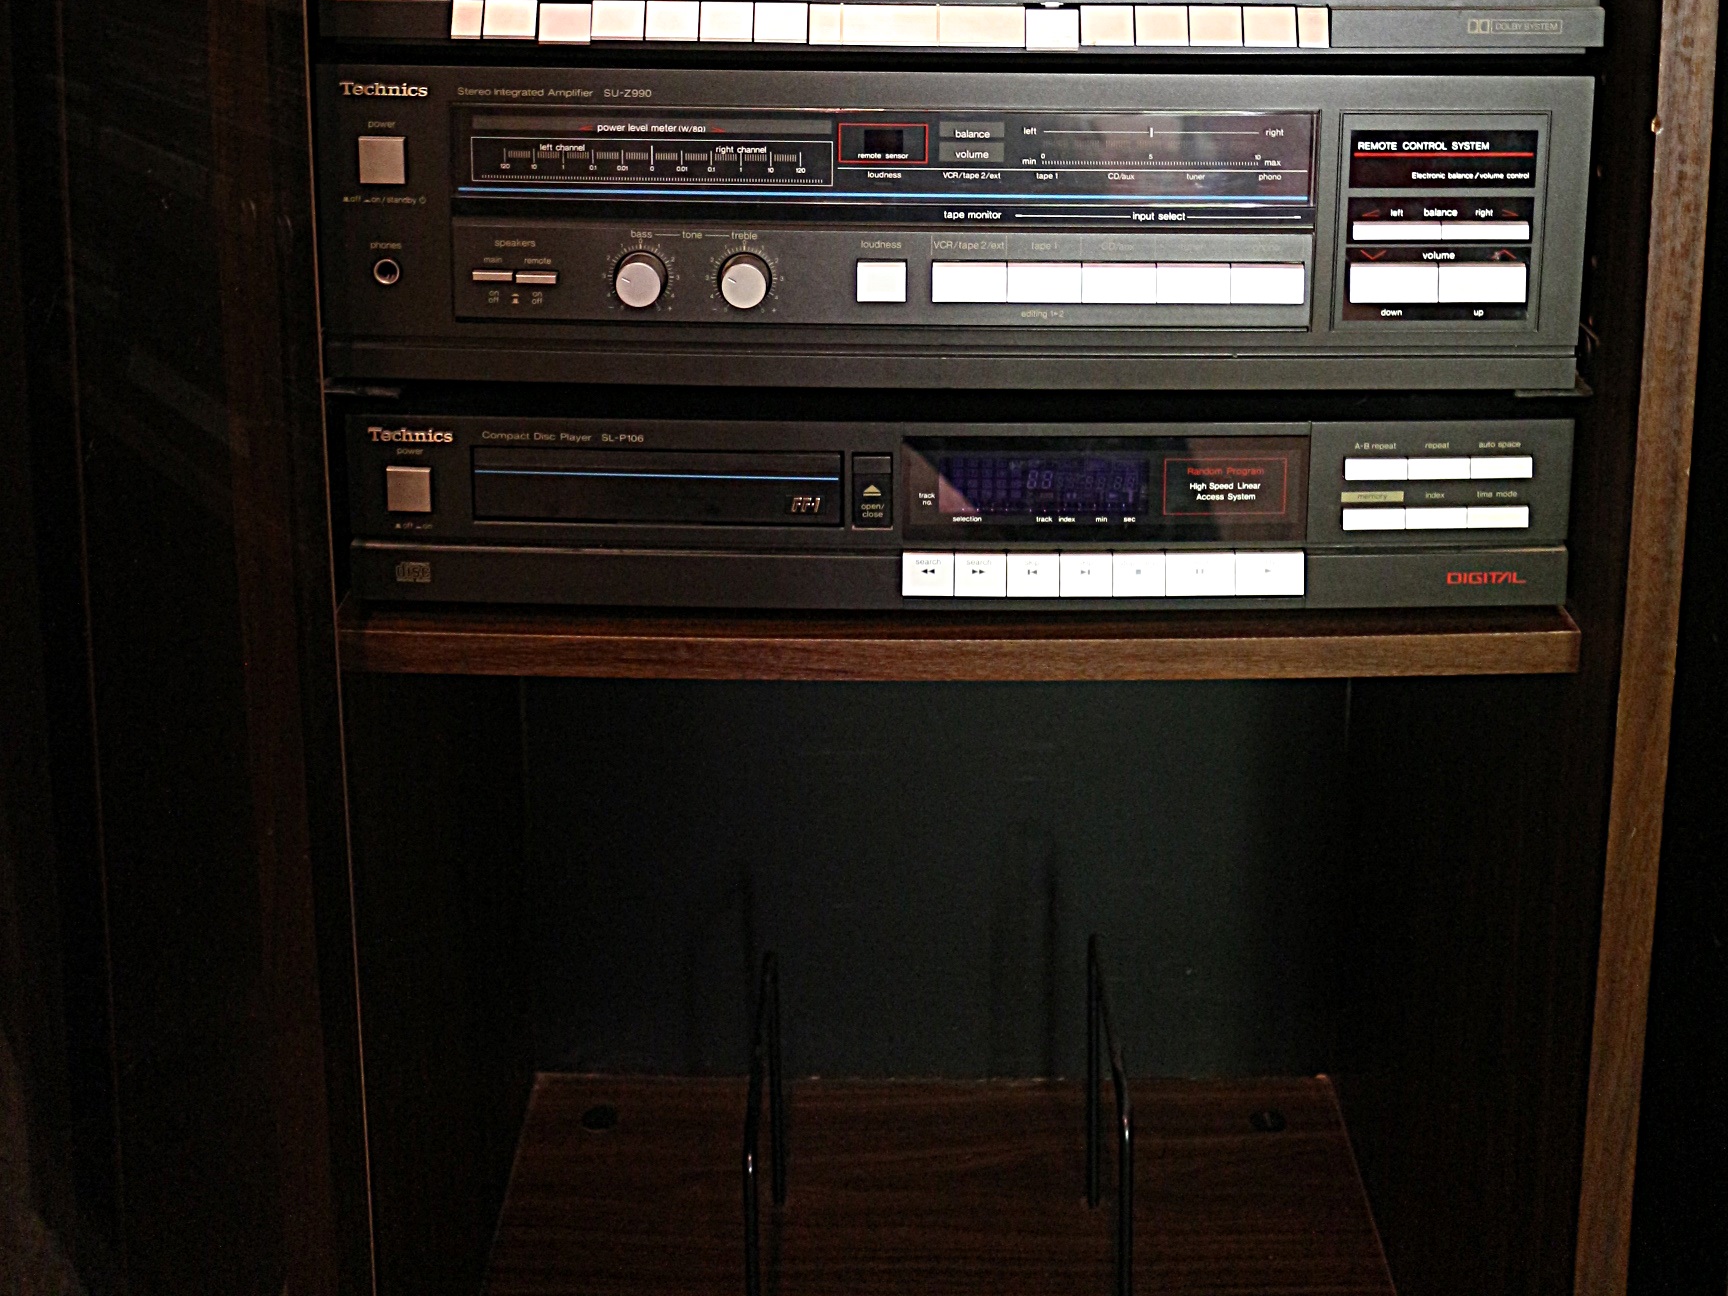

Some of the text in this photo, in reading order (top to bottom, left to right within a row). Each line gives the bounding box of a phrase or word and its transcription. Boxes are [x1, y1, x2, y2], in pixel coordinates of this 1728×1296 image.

[340, 82, 428, 97] Technics
[494, 88, 544, 97] Integrated
[548, 89, 593, 98] Amplifier
[604, 89, 651, 98] SU-Z990
[368, 121, 396, 129] power
[597, 124, 625, 132] power
[955, 130, 990, 139] balance
[1266, 129, 1284, 137] right
[1358, 142, 1489, 150] REMOTE CONTROL SYSTEM
[716, 146, 733, 155] right
[956, 151, 989, 159] volume
[1259, 173, 1281, 181] phono
[944, 211, 1002, 219] tape monitor
[1133, 212, 1154, 221] input
[1391, 209, 1403, 217] left
[1424, 209, 1458, 217] balance
[1476, 209, 1493, 217] right
[631, 231, 652, 239] bass
[731, 232, 757, 240] treble
[495, 239, 535, 247] speakers
[368, 427, 453, 443] Technics
[482, 431, 644, 443] Compact Disc Player SL-P106
[1227, 468, 1264, 476] Program
[1190, 482, 1207, 491] High
[1237, 482, 1260, 490] Linear
[1228, 493, 1255, 501] System
[1447, 572, 1526, 584] DIGITAL
